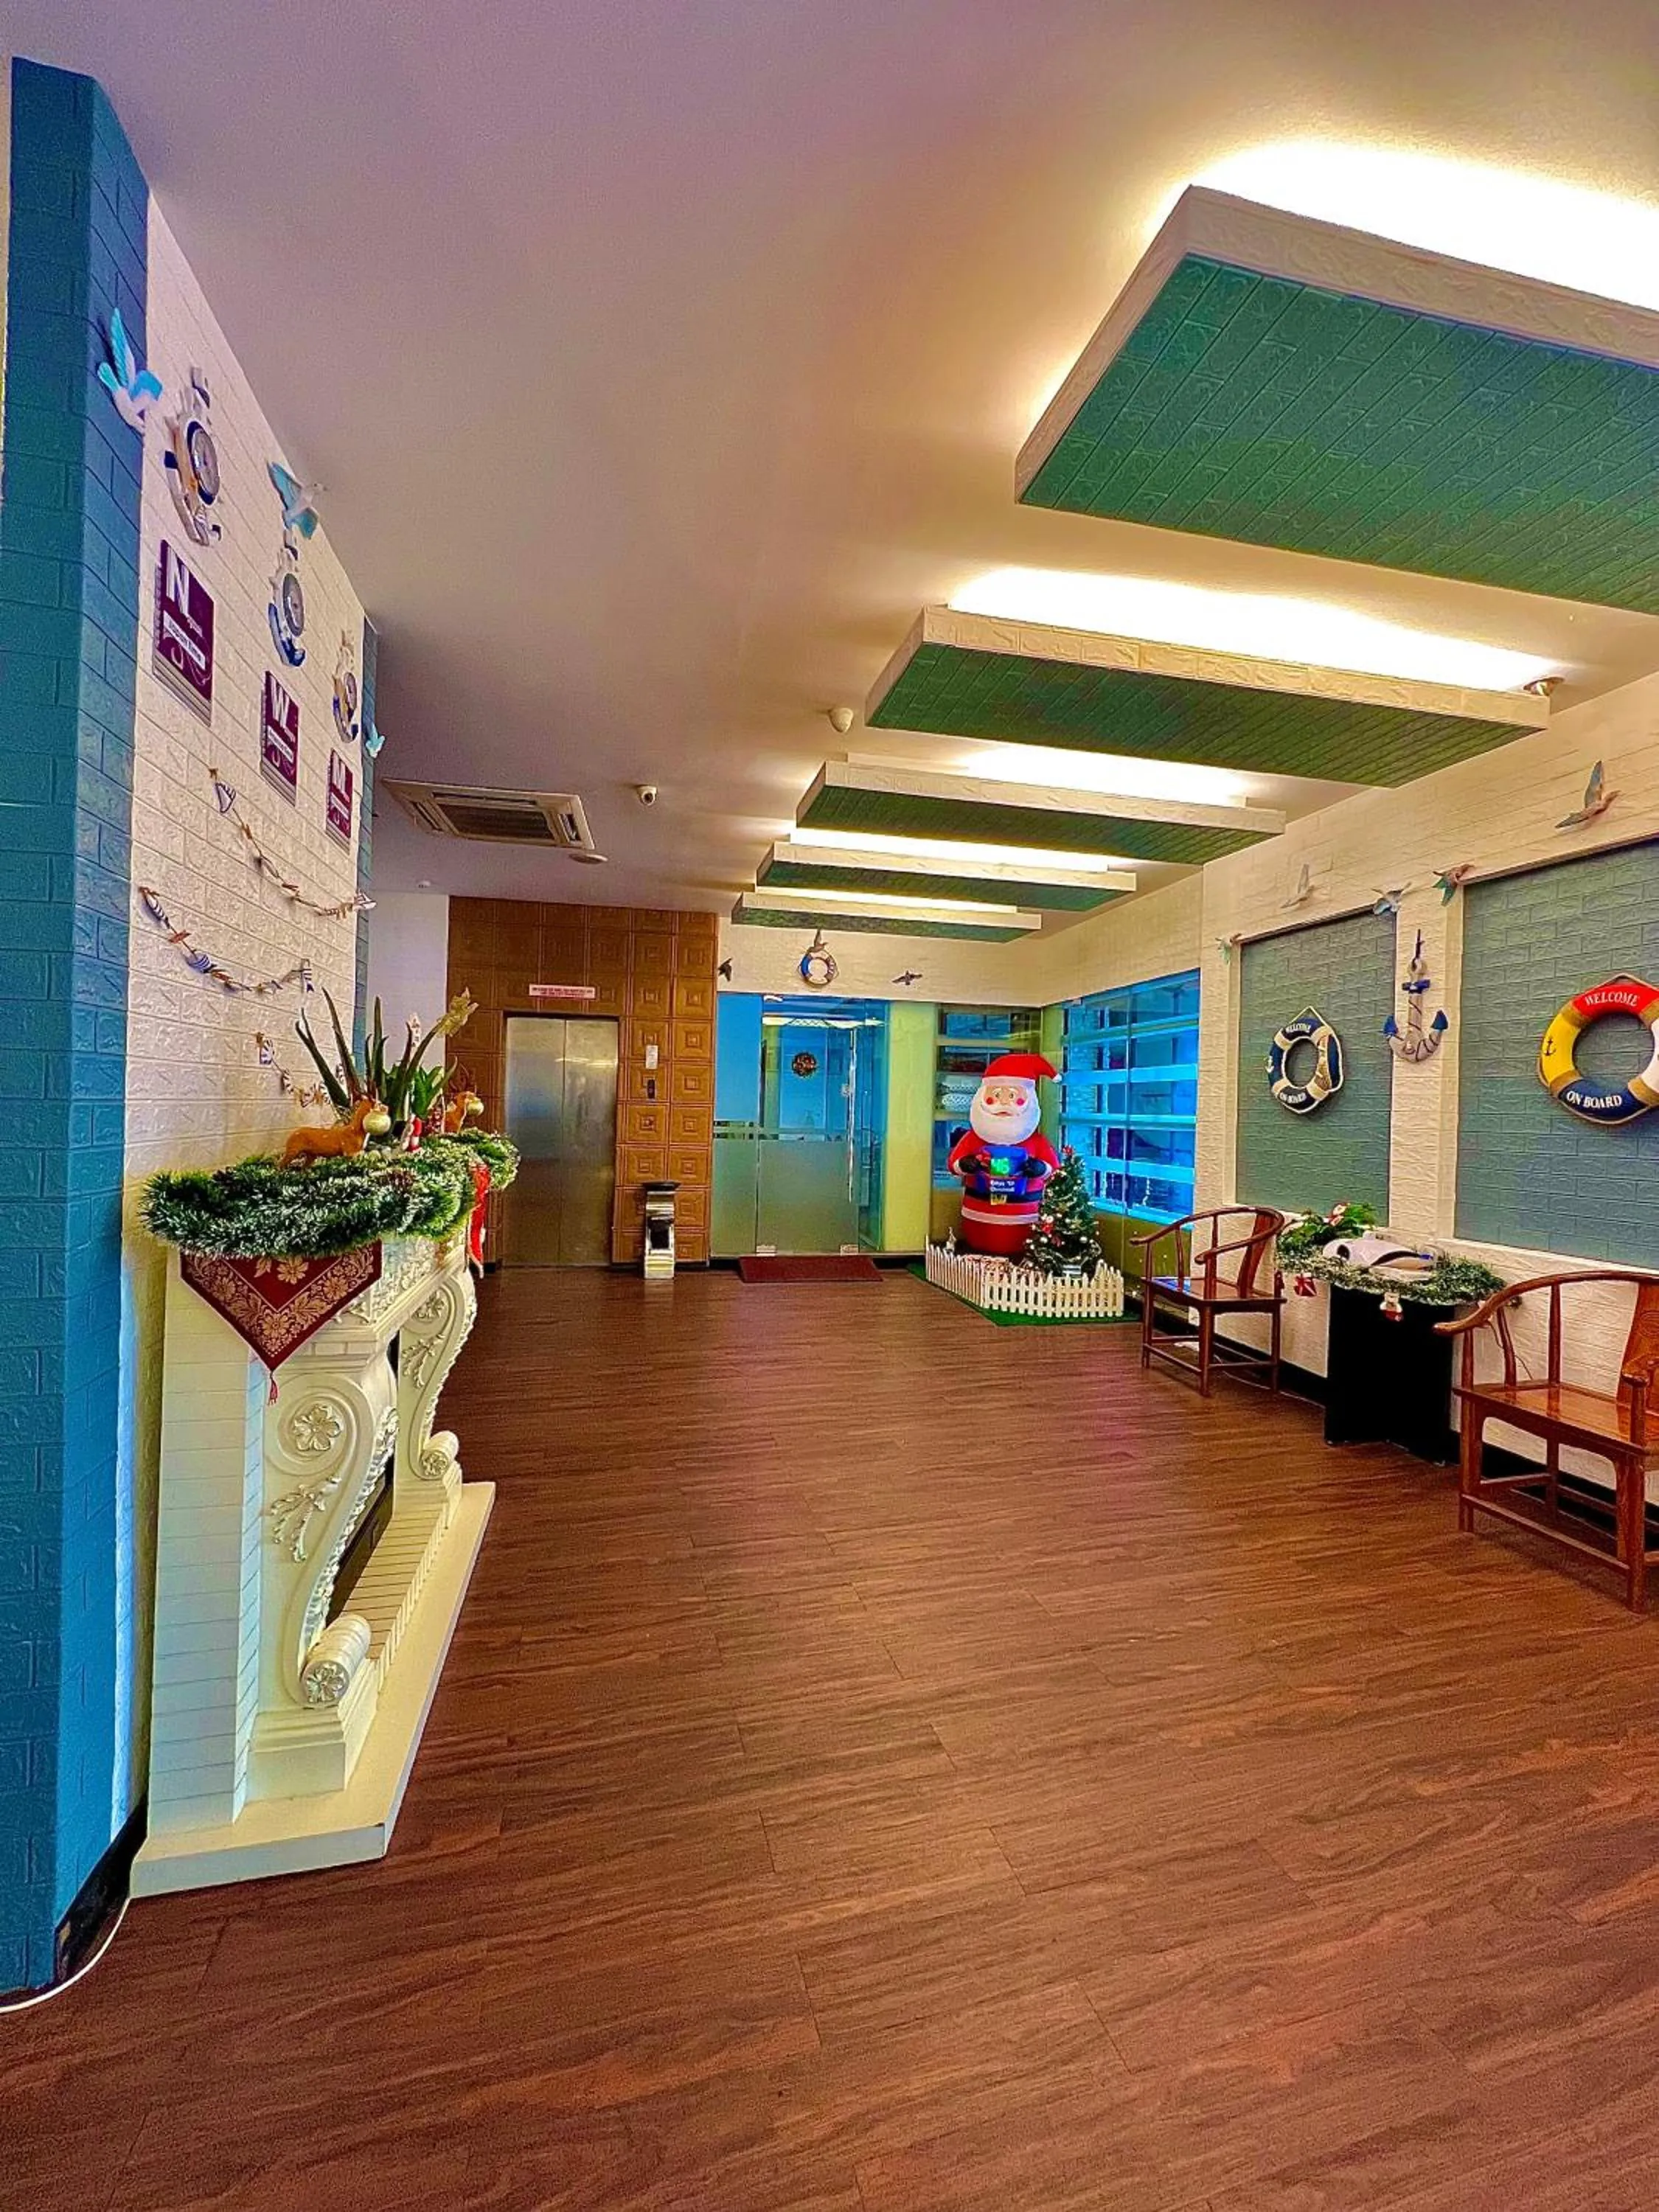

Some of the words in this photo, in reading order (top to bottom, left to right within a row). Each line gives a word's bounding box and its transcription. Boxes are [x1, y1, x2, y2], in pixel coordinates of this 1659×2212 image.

[1585, 991, 1639, 1006] WELCOME
[1566, 1091, 1583, 1105] ON
[1583, 1095, 1623, 1108] BOARD
